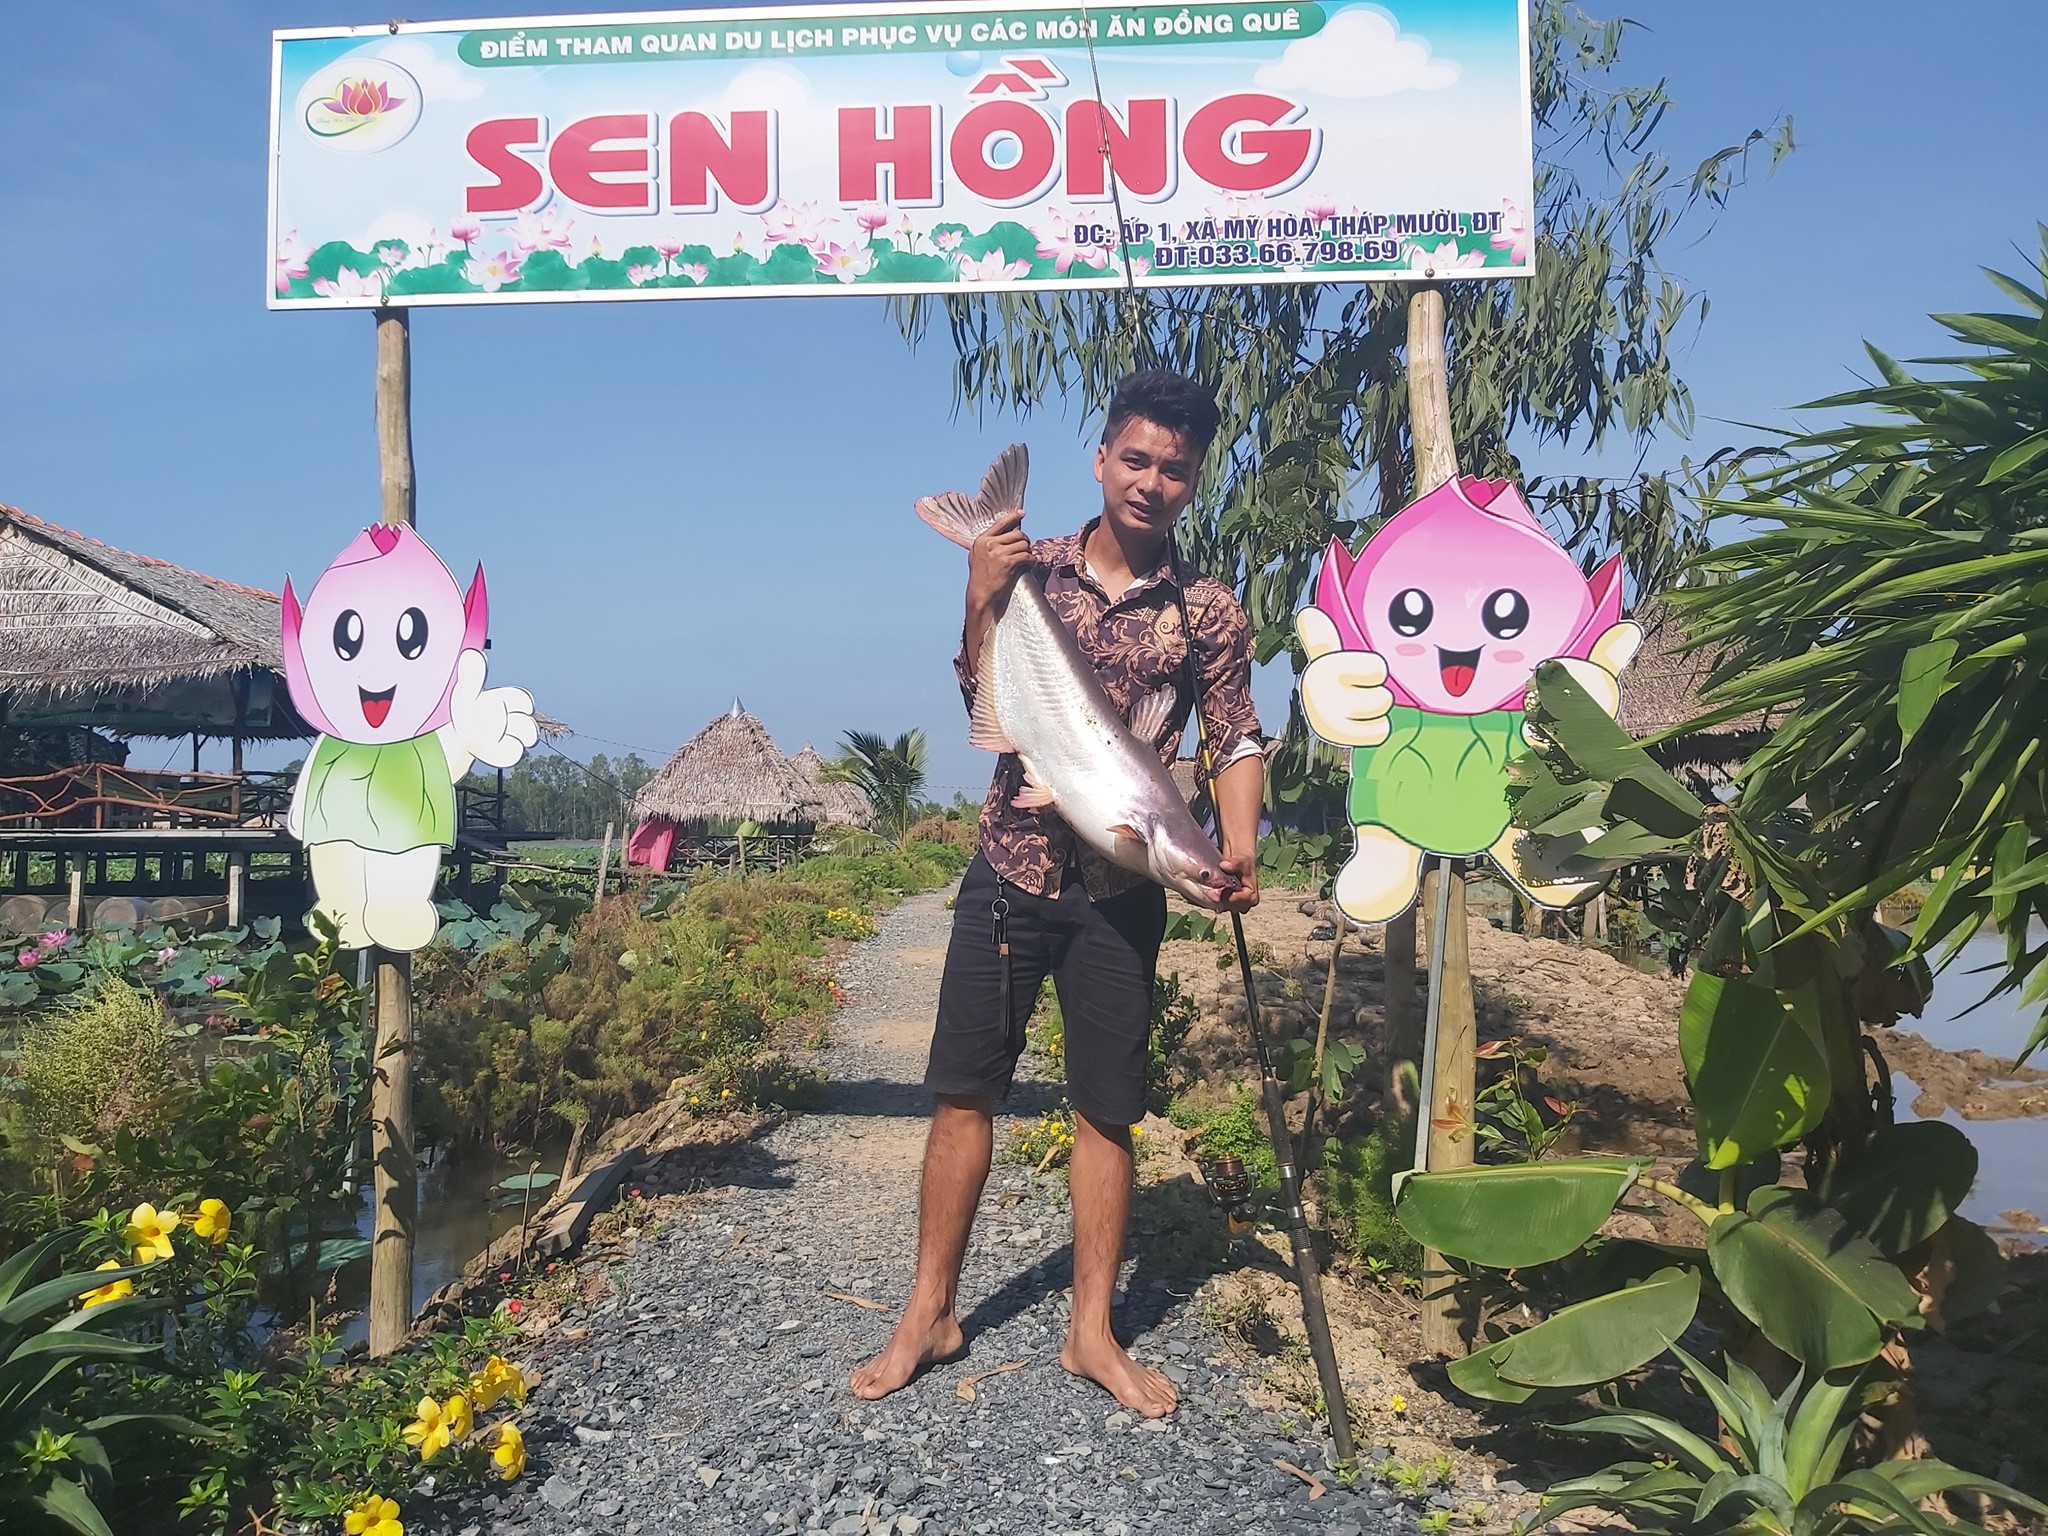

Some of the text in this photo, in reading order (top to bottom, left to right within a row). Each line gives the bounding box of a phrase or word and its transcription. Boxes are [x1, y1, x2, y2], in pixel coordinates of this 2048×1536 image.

[480, 8, 1300, 59] ĐIỂM THAM QUAN DU LỊCH PHỤC VỤ CÁC MÓN ĂN ĐỒNG QUÊ
[466, 58, 1313, 213] SEN HỒNG
[1074, 208, 1503, 244] ĐC: ẤP 1, XÃ MỸ HÒA, THÁP MƯỜI, ĐT
[1155, 240, 1398, 267] ĐT:033.66.798.69
